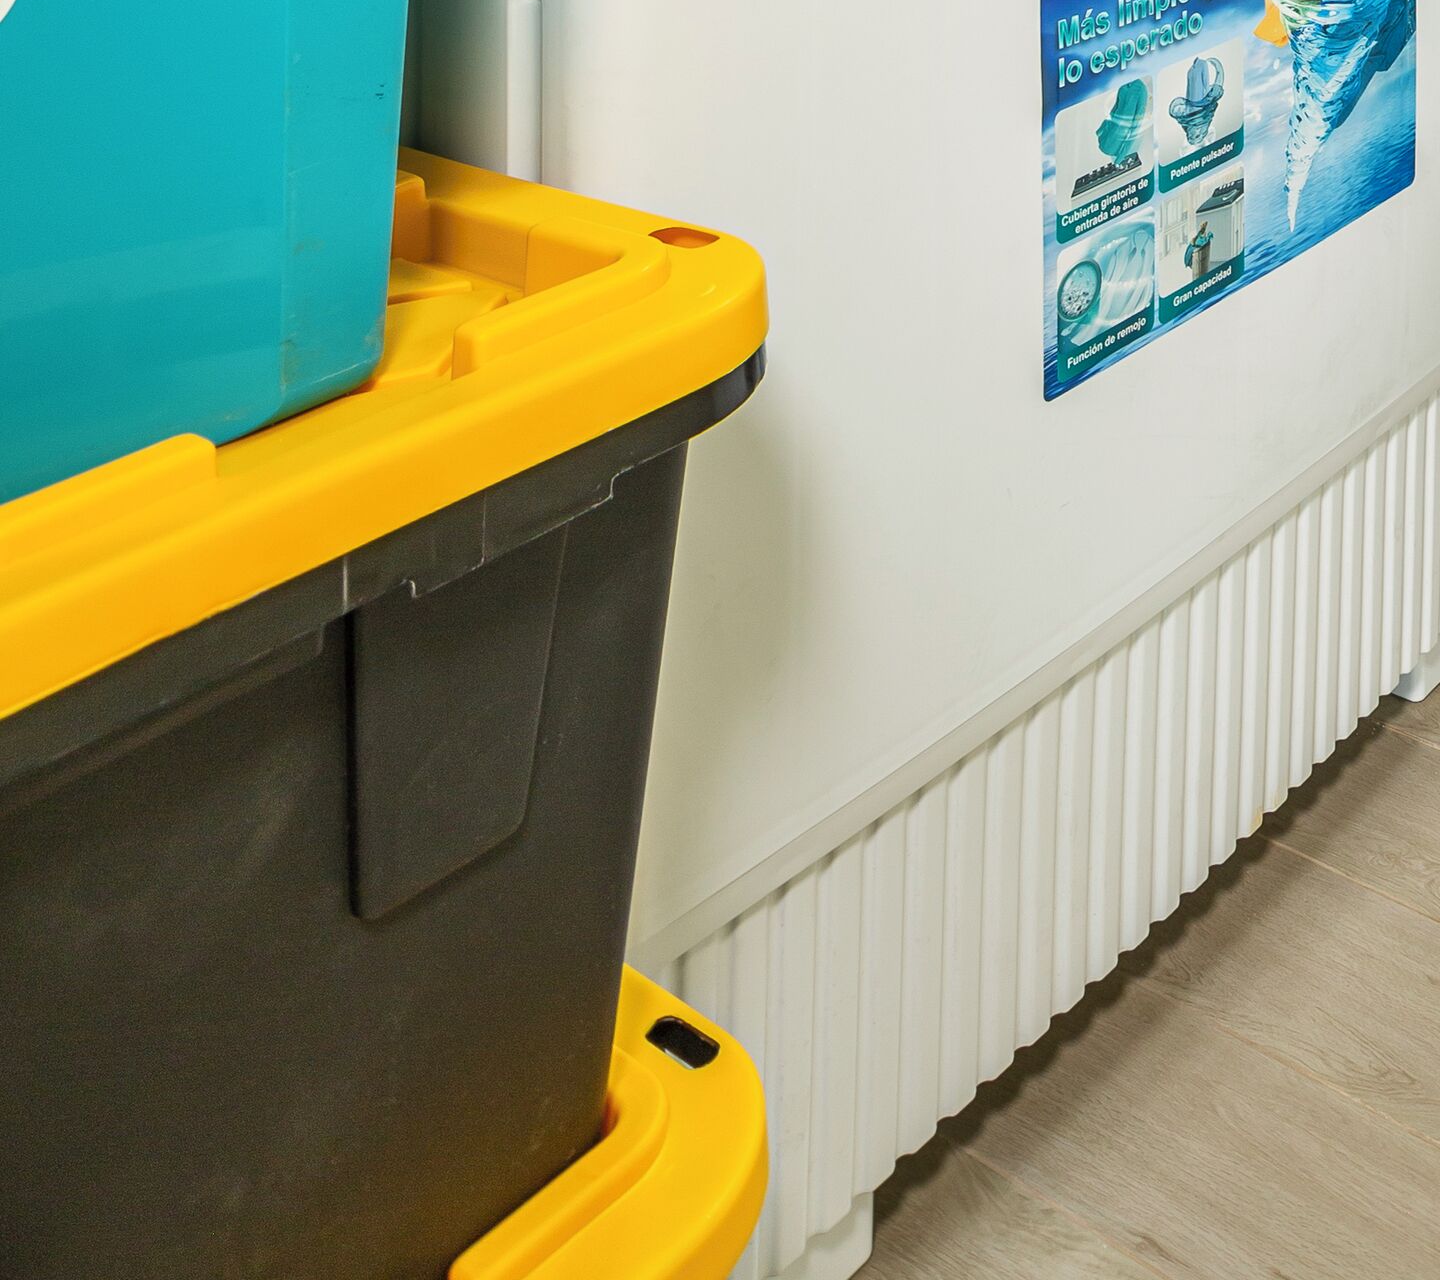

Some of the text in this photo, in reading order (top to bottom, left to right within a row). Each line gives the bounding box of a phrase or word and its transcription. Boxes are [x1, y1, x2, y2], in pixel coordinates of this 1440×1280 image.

[1057, 8, 1111, 49] Más
[1058, 10, 1204, 88] lo esperado
[1170, 142, 1235, 181] Potente pulsador
[1061, 177, 1149, 227] Cubierta giratoria de
[1075, 197, 1139, 234] entrada de aire
[1173, 265, 1232, 307] Gran capacidad
[1067, 317, 1147, 369] Función de remojo
